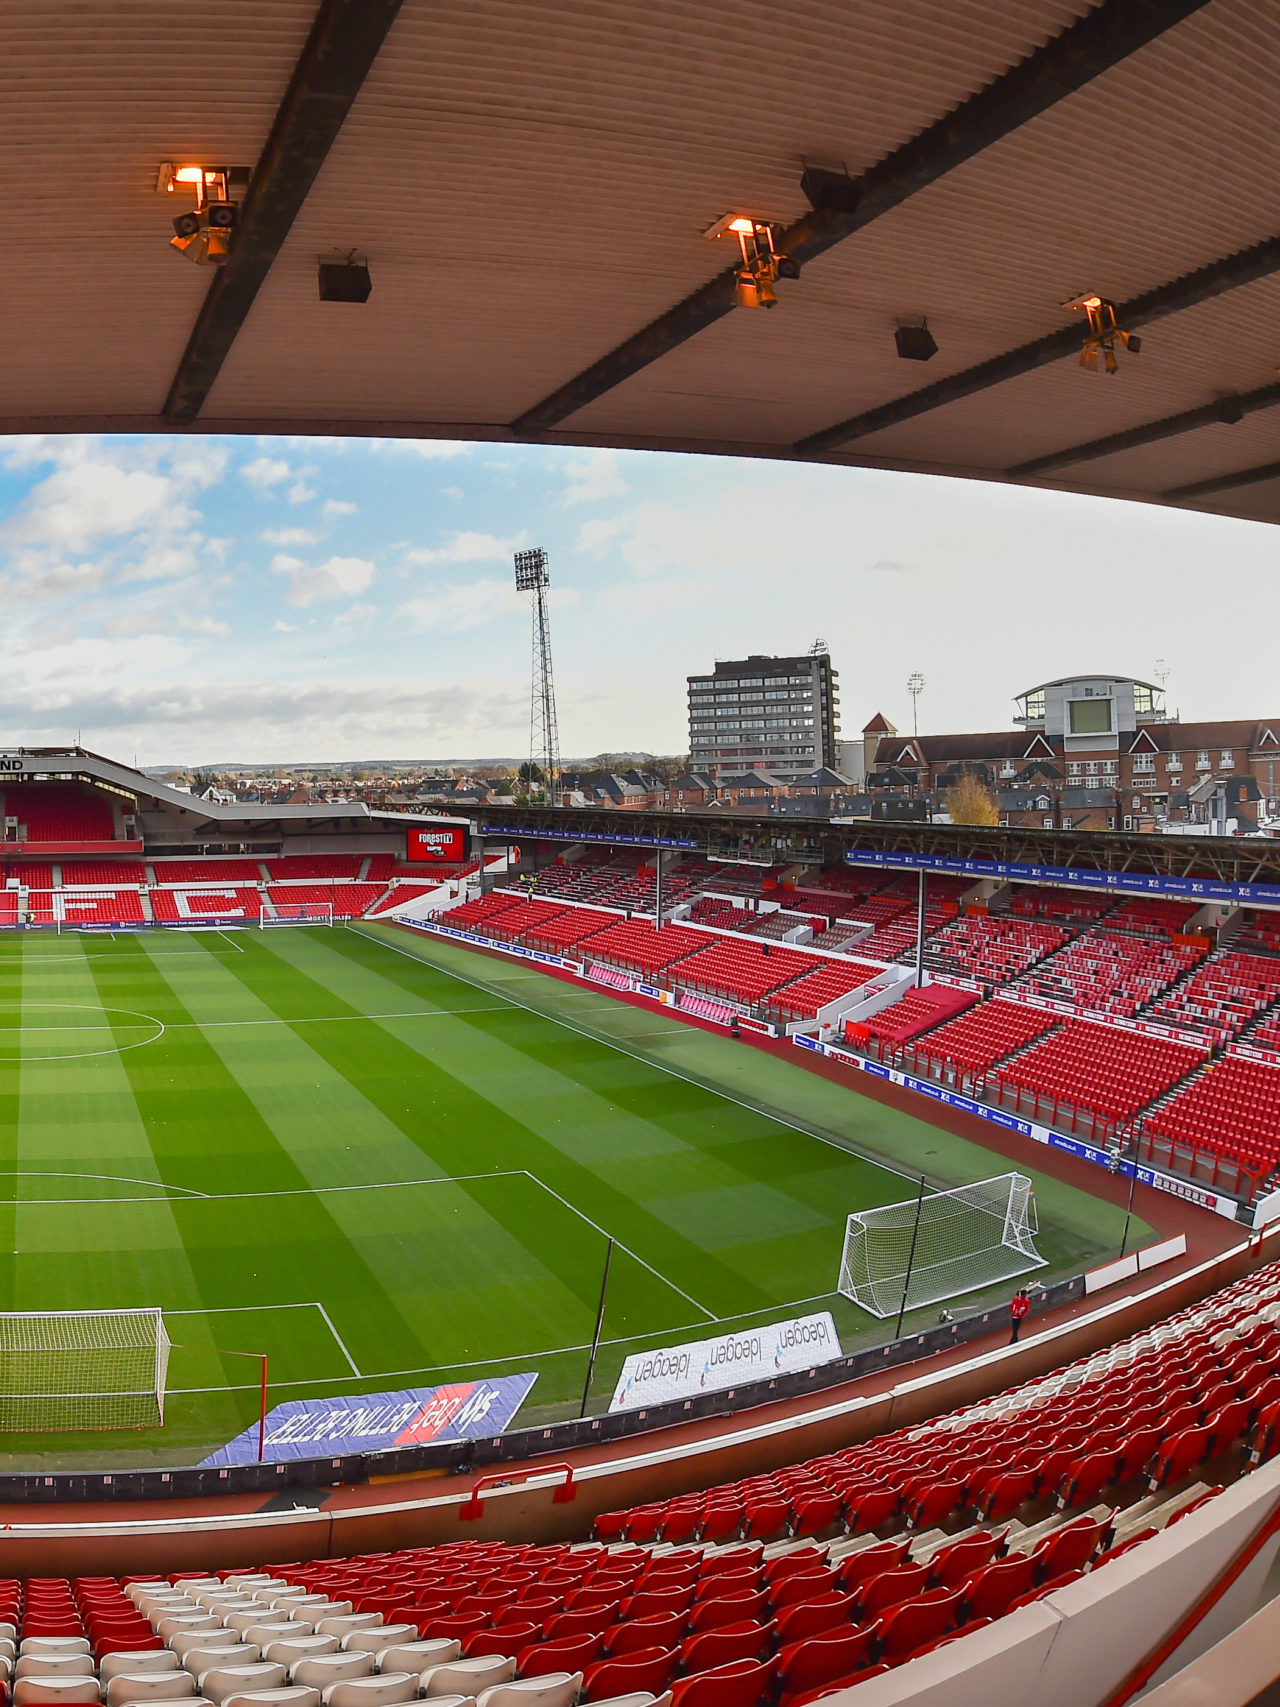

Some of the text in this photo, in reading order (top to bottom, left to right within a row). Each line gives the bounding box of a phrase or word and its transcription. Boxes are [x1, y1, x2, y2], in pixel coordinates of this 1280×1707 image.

[780, 1320, 831, 1350] Ideagen
[710, 1336, 762, 1367] Ideagen
[634, 1351, 691, 1385] Ideagen
[263, 1384, 500, 1446] sky bet BETTING BETTER
